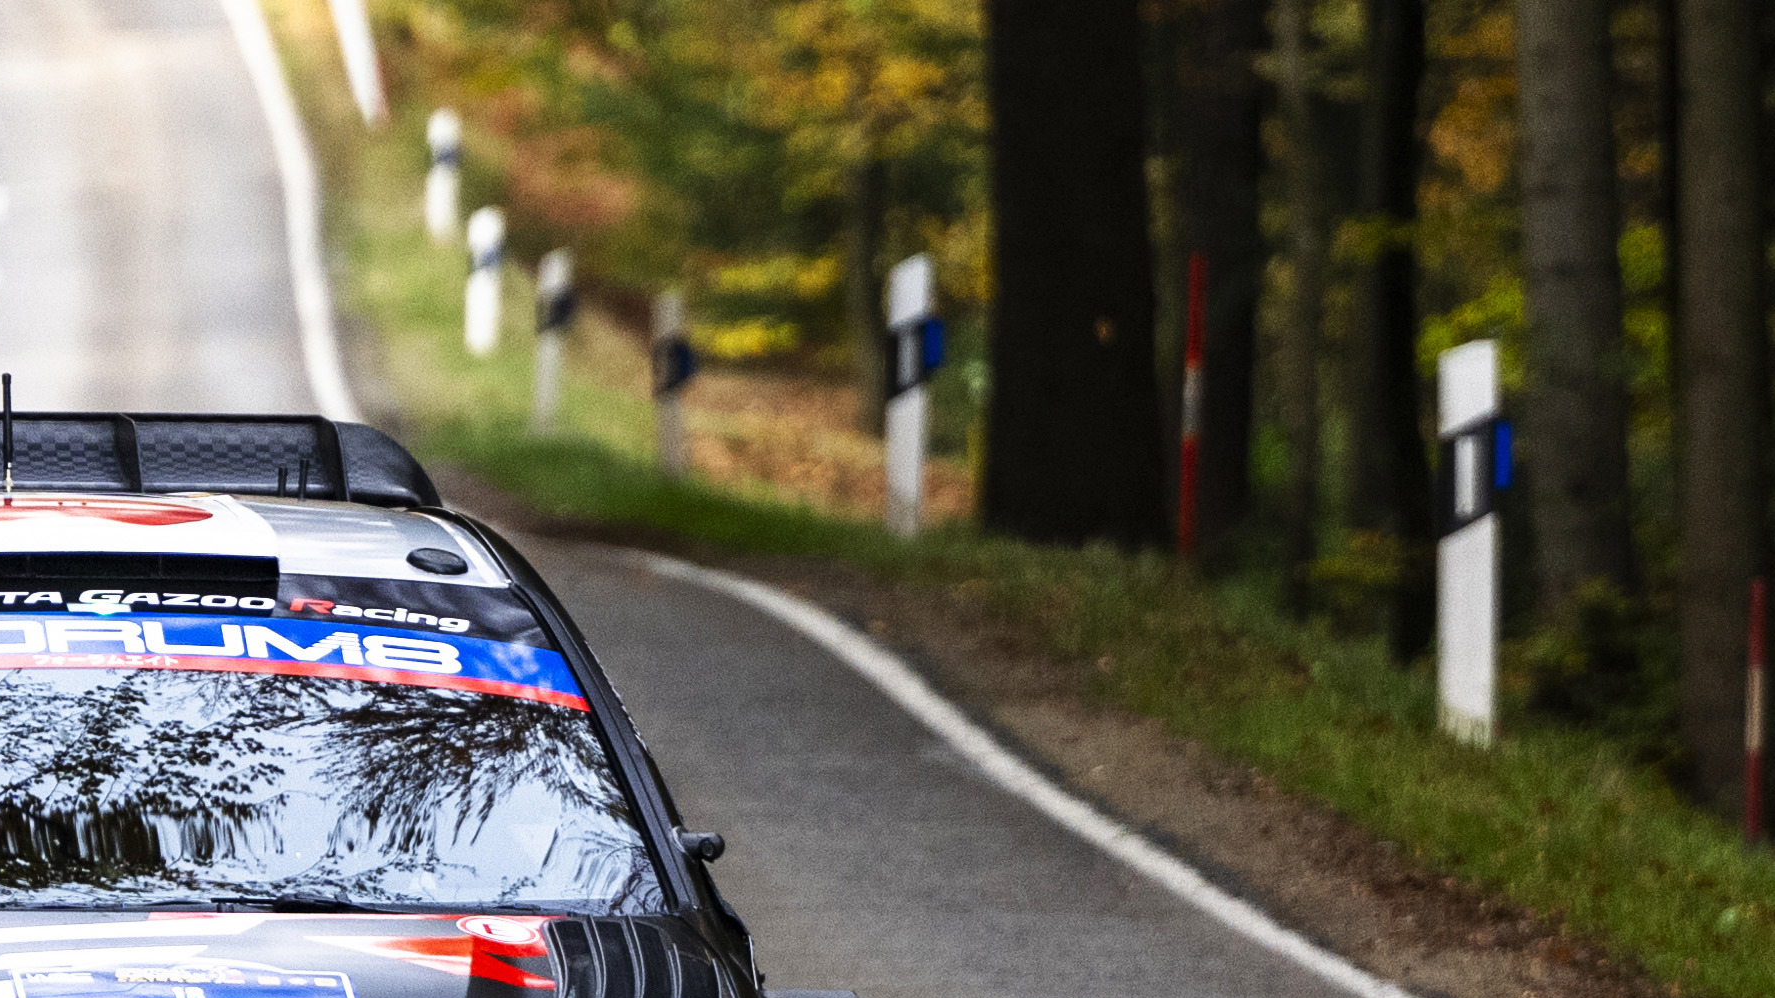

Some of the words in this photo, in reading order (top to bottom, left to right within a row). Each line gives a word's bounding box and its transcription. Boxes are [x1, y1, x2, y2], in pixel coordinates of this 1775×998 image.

[289, 598, 470, 633] Racing
[32, 654, 179, 667] フォーラムエイト
